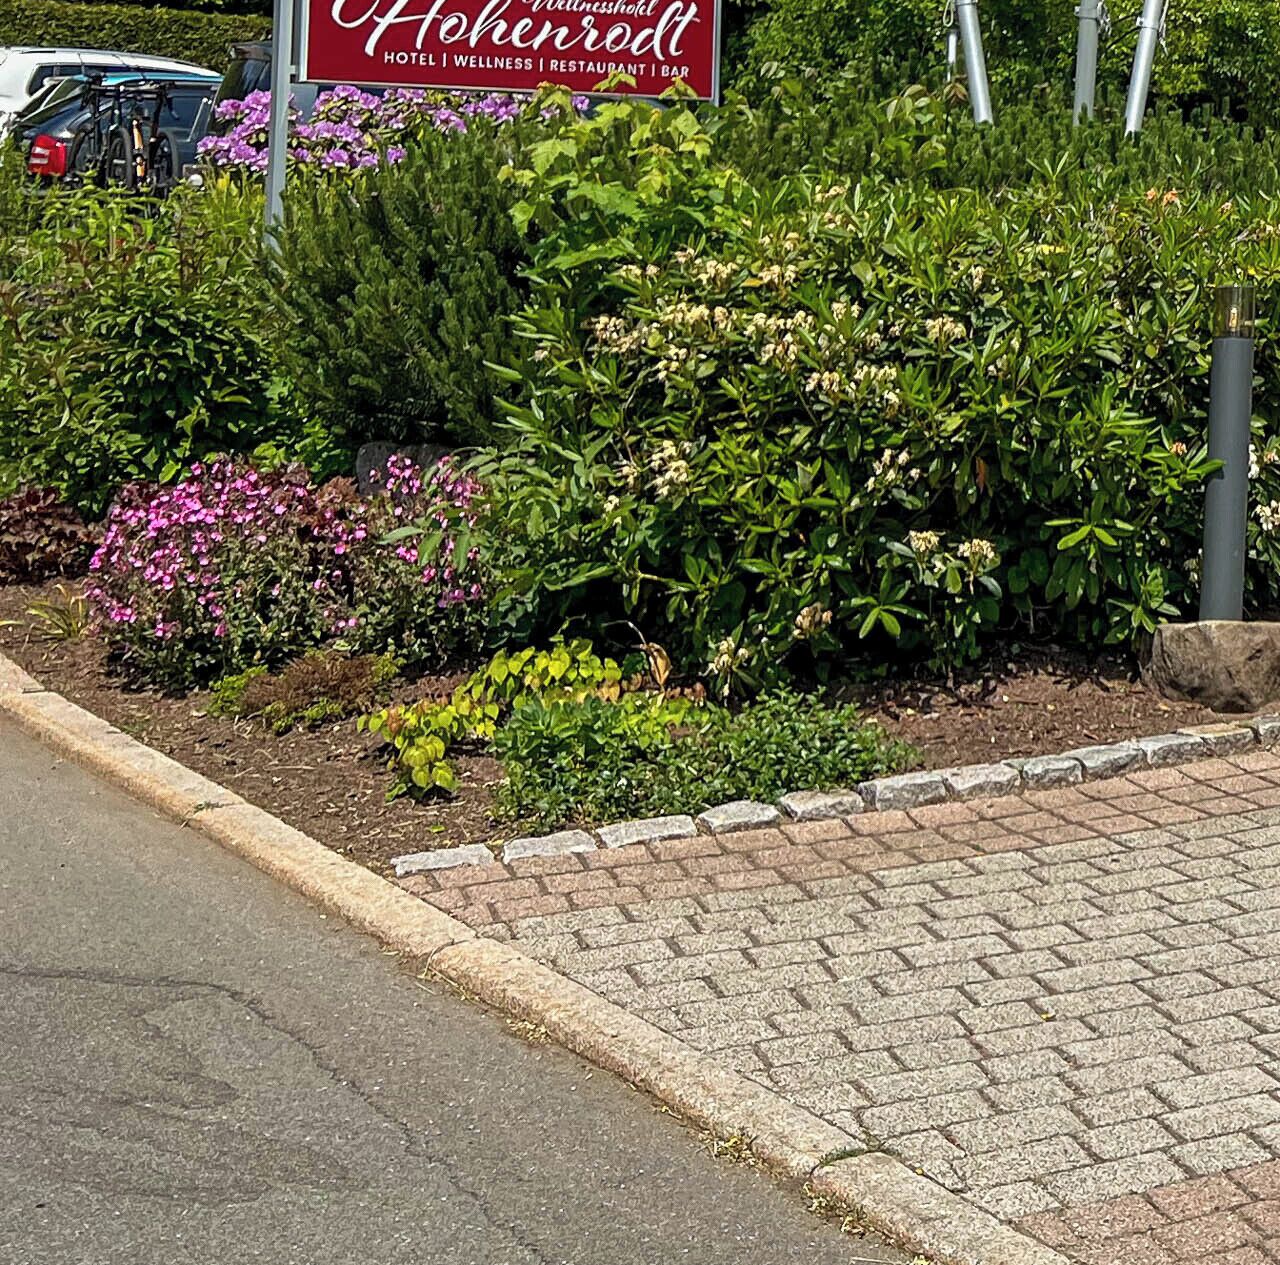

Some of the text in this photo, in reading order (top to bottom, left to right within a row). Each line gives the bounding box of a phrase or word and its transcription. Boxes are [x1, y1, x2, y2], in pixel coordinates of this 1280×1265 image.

[384, 51, 436, 66] HOTEL
[454, 54, 533, 71] WELLNESS
[550, 59, 646, 77] RESTAURANT
[661, 65, 690, 78] BAR
